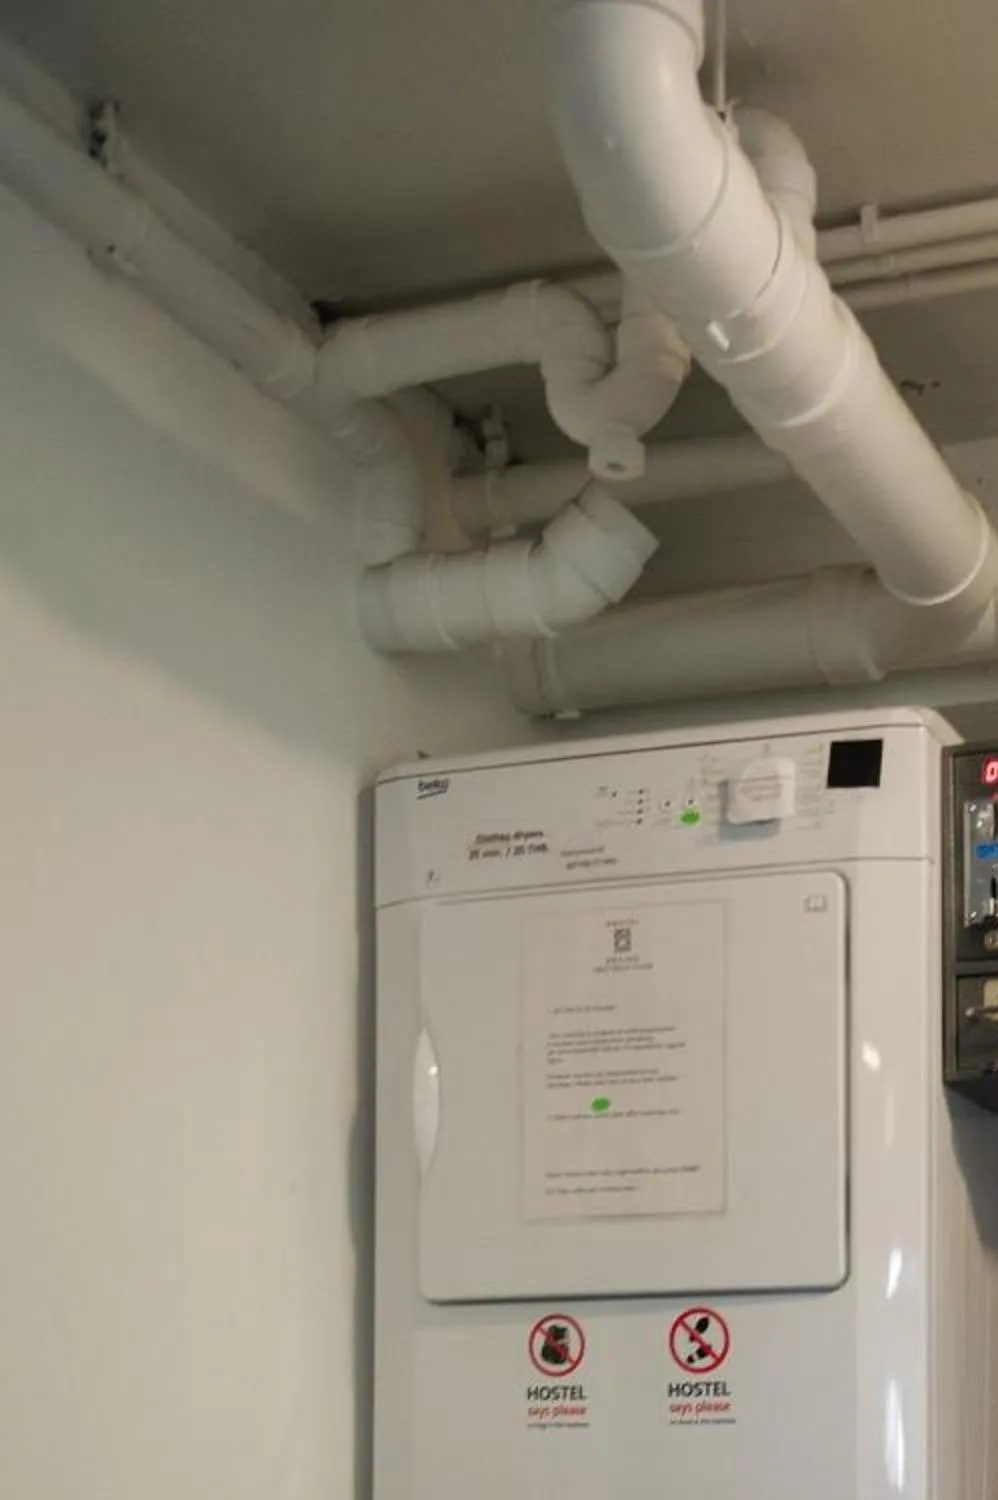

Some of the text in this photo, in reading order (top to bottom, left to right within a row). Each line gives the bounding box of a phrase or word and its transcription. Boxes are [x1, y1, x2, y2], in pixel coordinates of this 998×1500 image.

[527, 1384, 588, 1402] HOSTEL
[667, 1381, 732, 1398] HOSTEL
[527, 1404, 587, 1420] says please
[669, 1400, 731, 1417] says please
